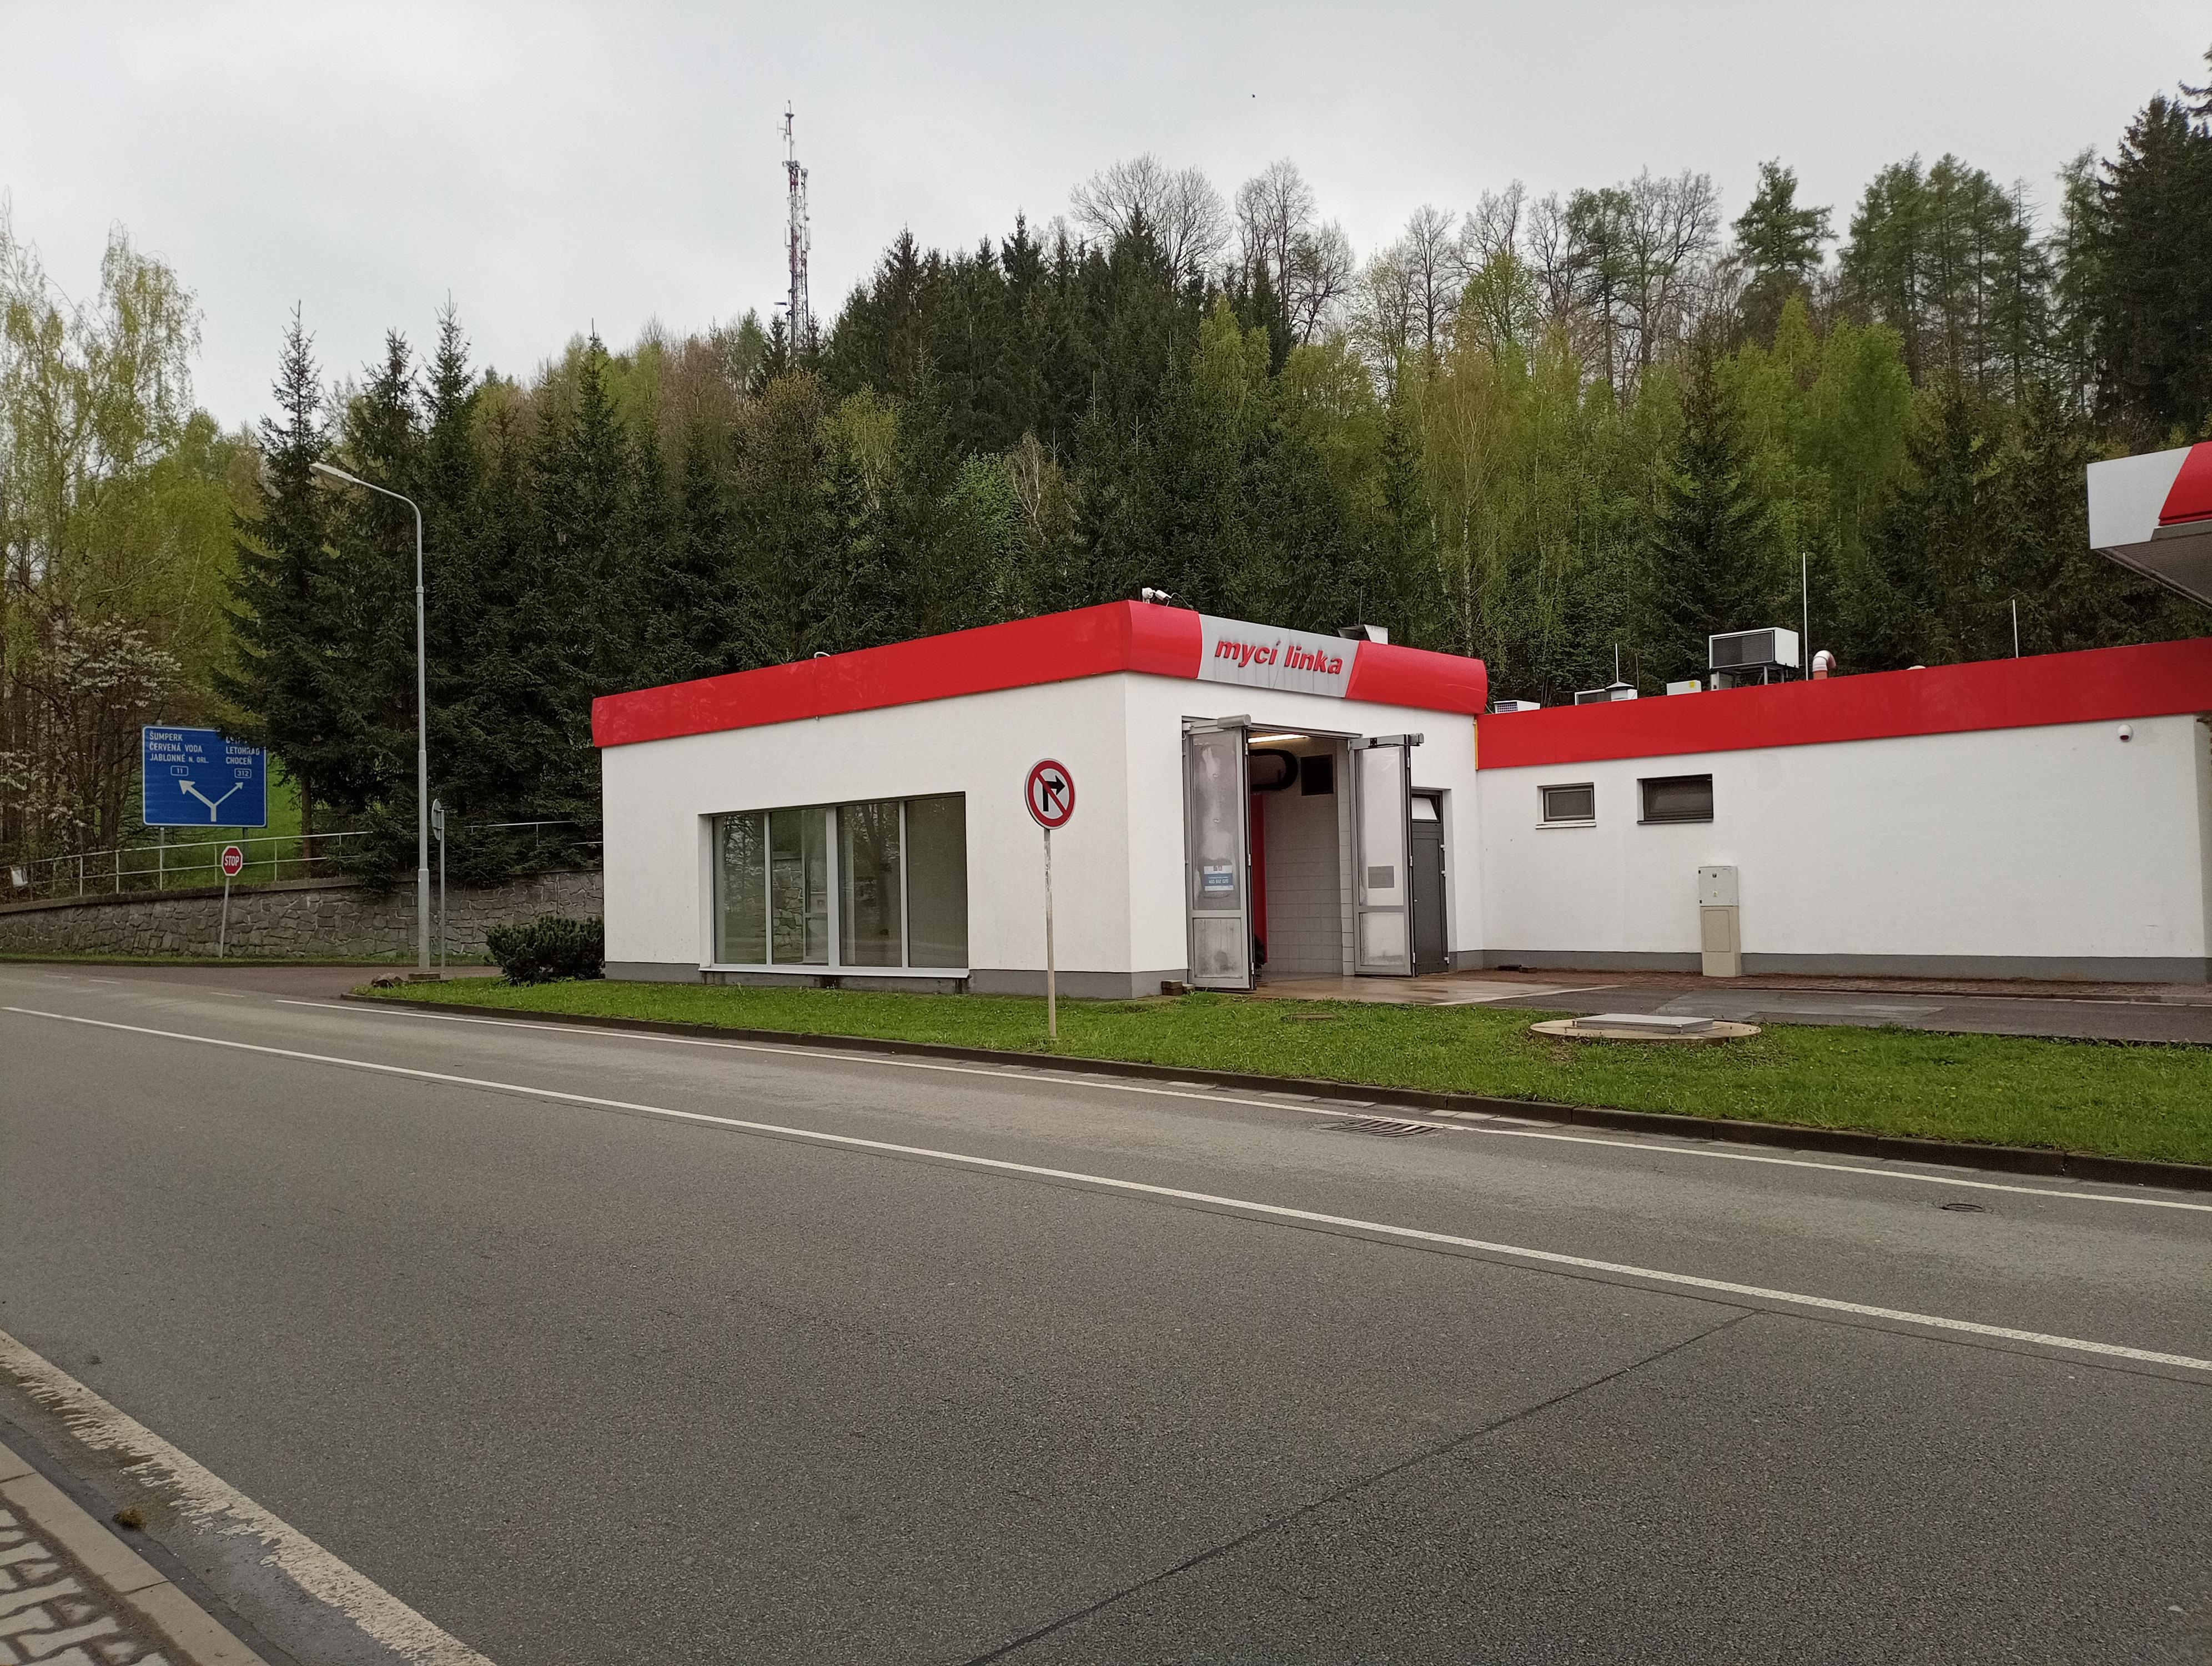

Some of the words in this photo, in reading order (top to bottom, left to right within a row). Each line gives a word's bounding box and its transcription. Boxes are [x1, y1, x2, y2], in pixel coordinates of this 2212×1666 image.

[1214, 639, 1281, 668] mycí
[1284, 645, 1343, 674] linka
[149, 730, 183, 741] ŠUMPERK
[149, 741, 181, 752] ČERVENÁ
[185, 744, 203, 753] VODA
[150, 752, 185, 762] JABLONNÉ
[225, 756, 252, 765] CHOCEŇ
[224, 856, 240, 866] STOP
